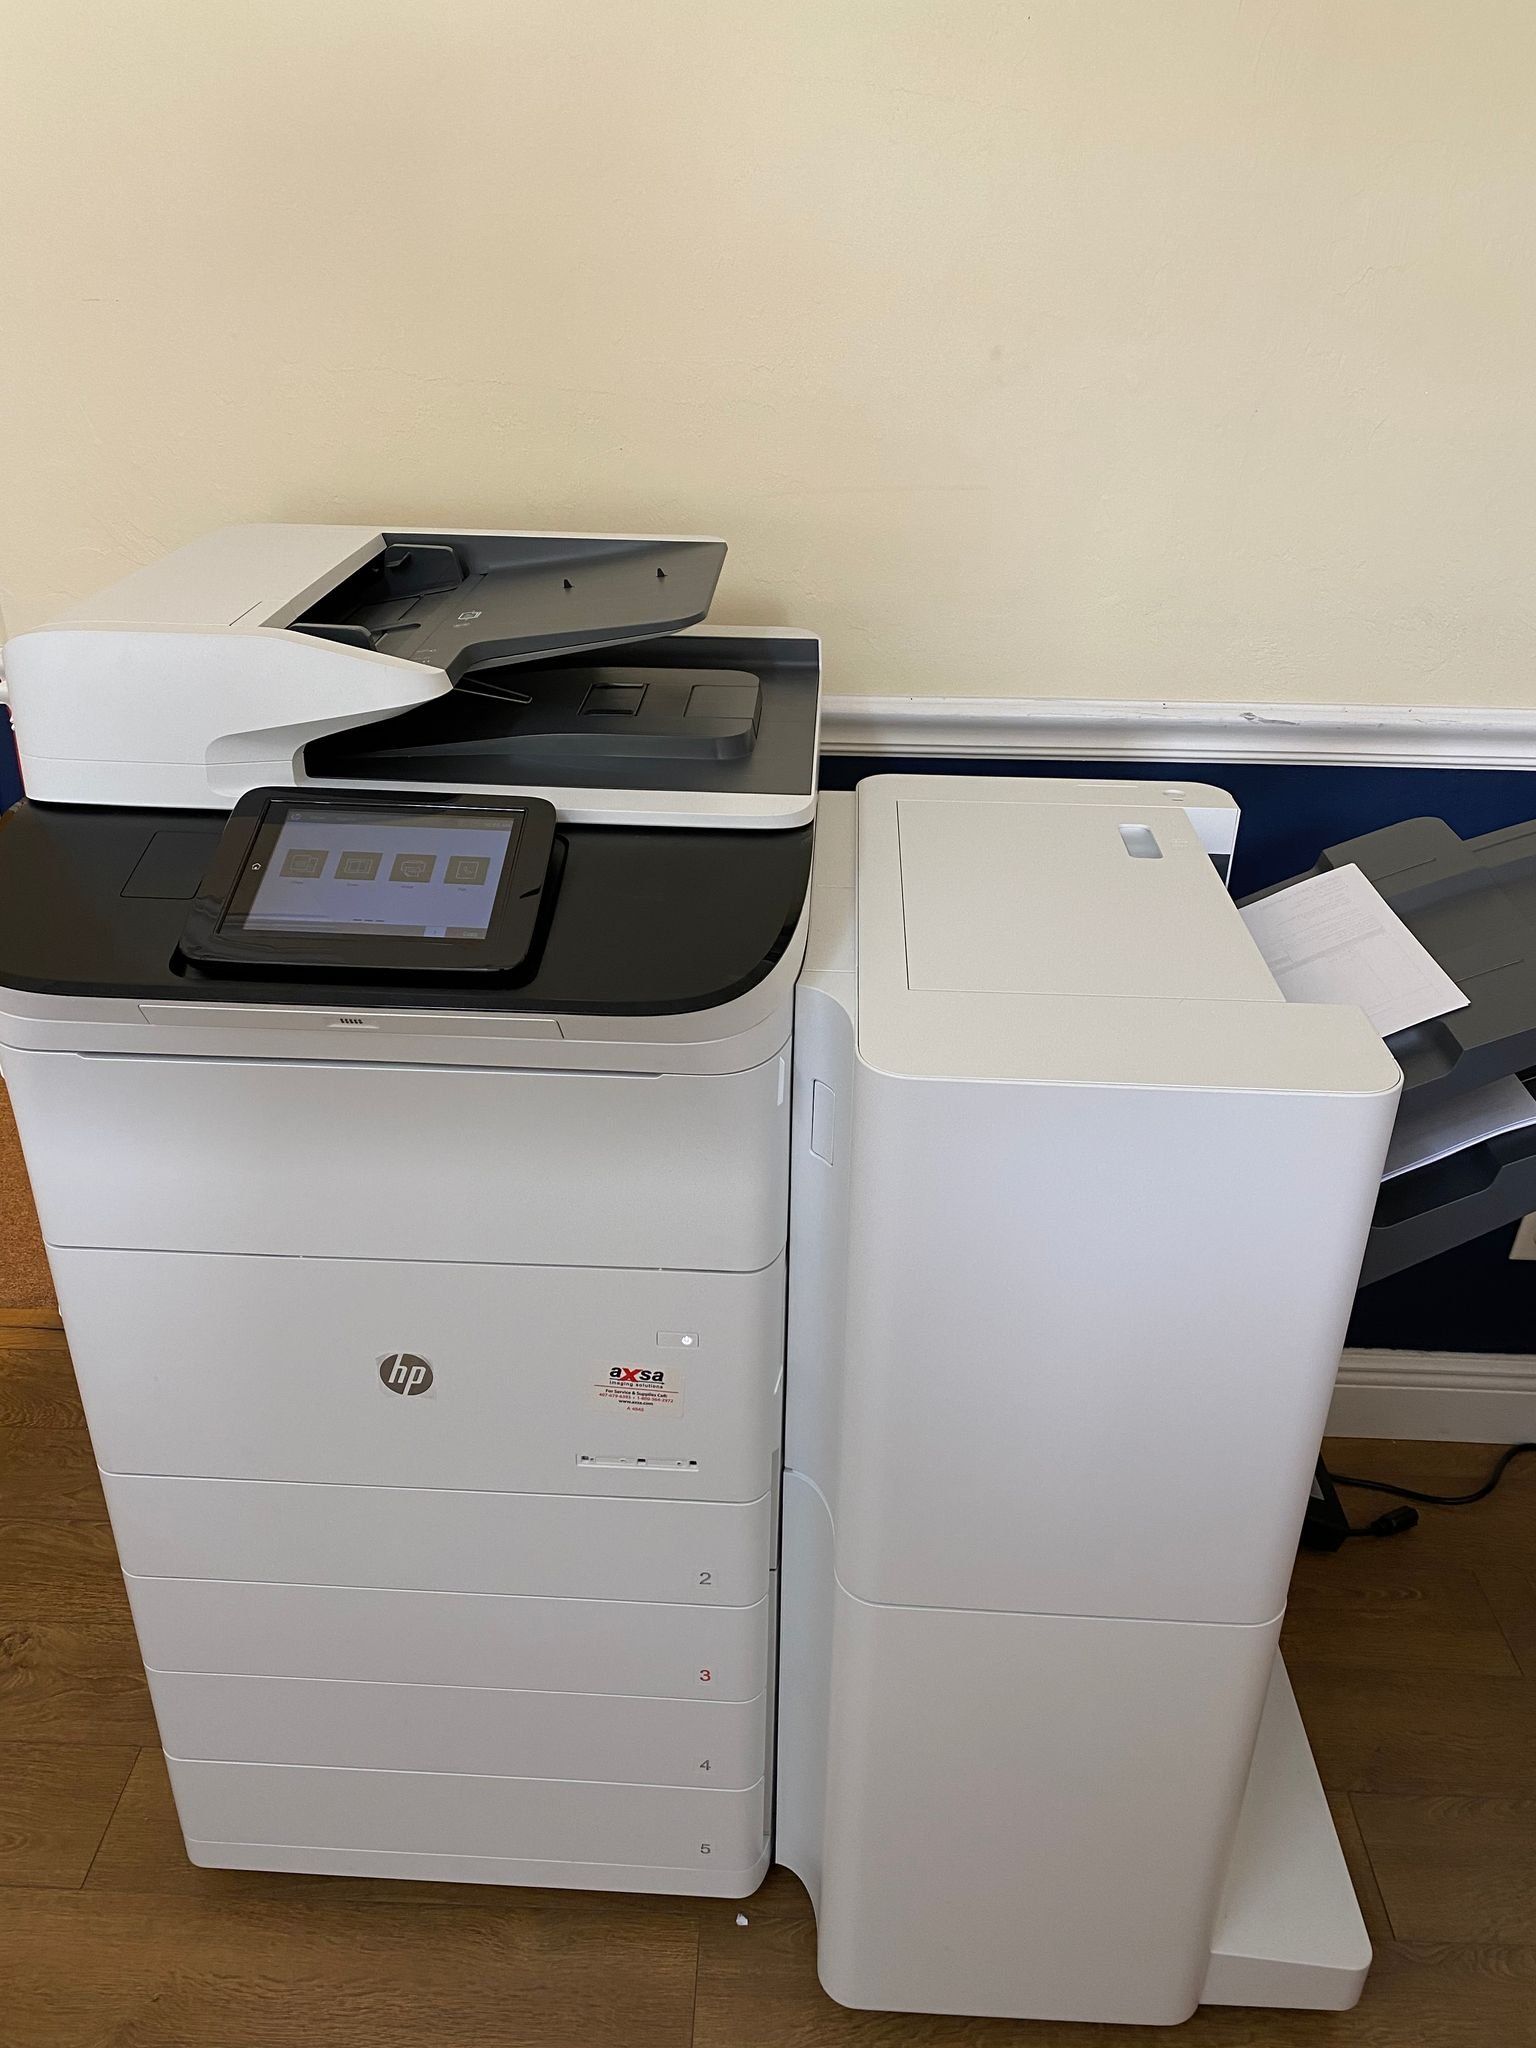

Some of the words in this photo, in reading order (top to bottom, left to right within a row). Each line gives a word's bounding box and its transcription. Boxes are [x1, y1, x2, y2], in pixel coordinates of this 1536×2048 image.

[388, 1353, 427, 1396] hp
[609, 1366, 664, 1382] axsa
[699, 1572, 712, 1585] 2
[699, 1669, 712, 1682] 3
[699, 1759, 712, 1772] 4
[699, 1843, 712, 1856] 5
